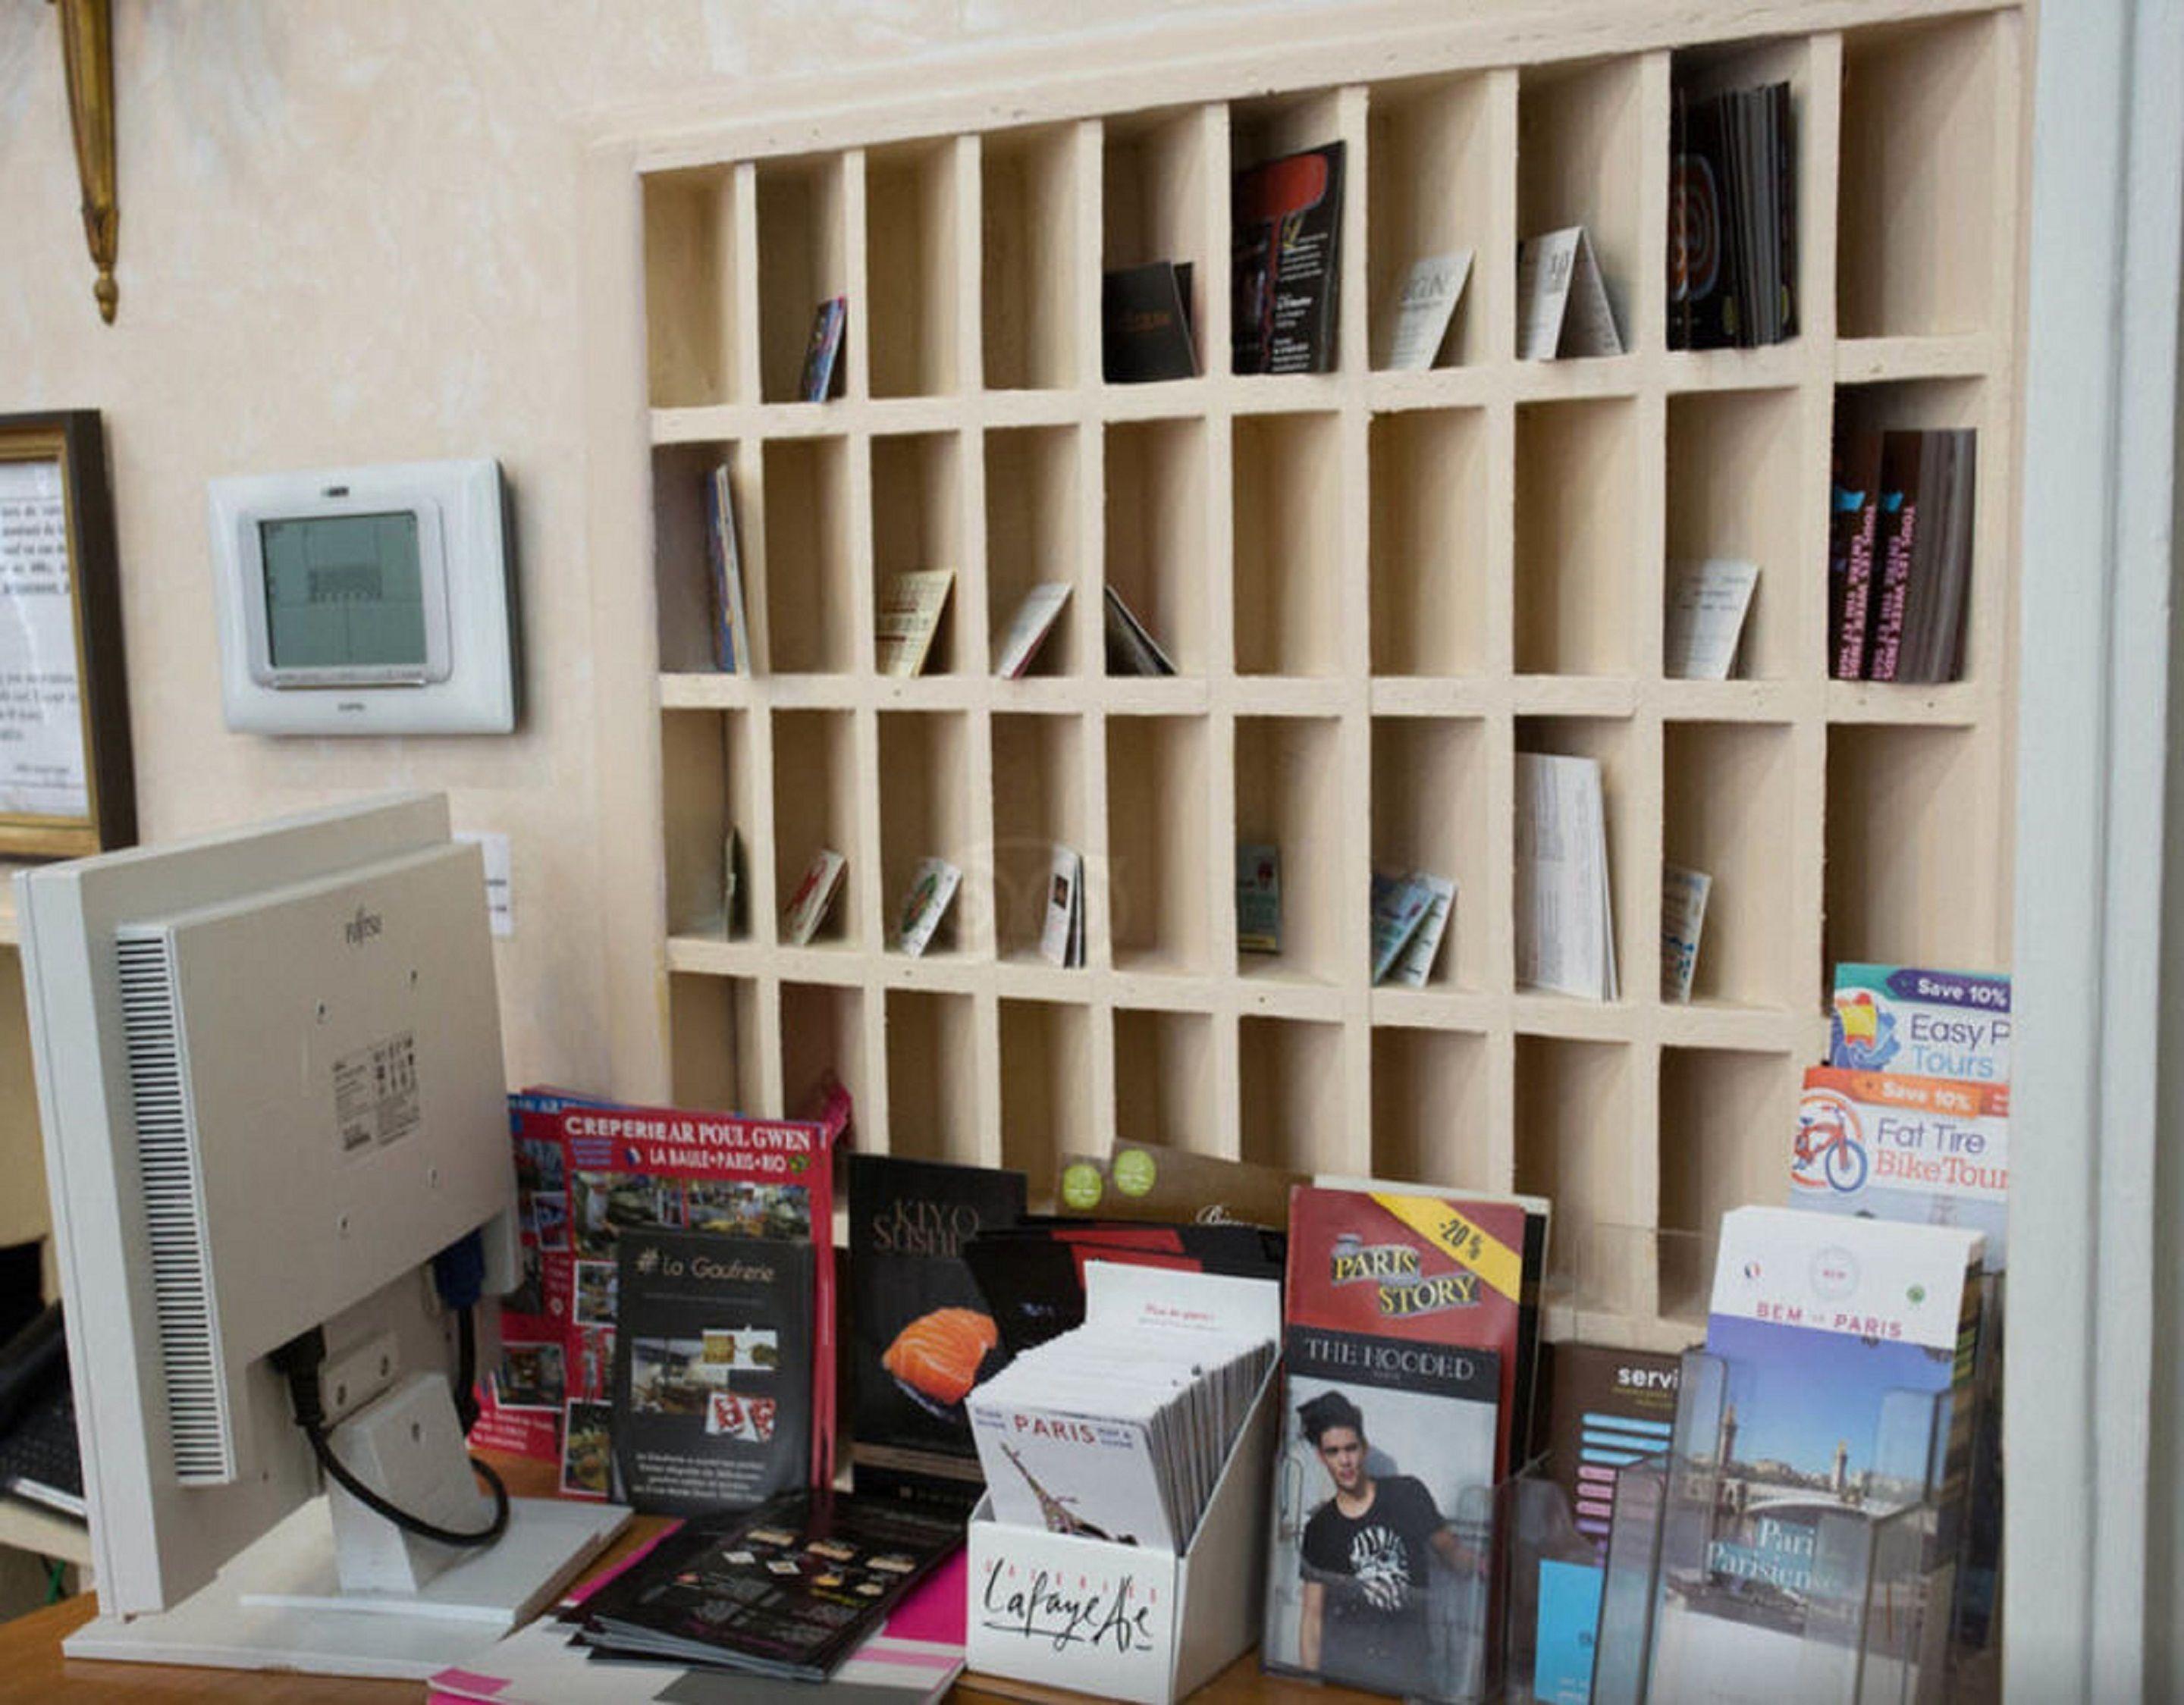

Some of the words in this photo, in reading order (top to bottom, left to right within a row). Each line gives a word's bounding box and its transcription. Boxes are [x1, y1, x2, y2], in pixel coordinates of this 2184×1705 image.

[1916, 977, 1964, 1000] Save
[1970, 983, 2008, 1007] 10%
[1910, 1013, 1985, 1051] Easy
[1991, 1020, 2010, 1045] P
[1911, 1046, 1994, 1079] Tours
[698, 1123, 750, 1148] POUL
[752, 1126, 811, 1152] GWEN
[1877, 1117, 1925, 1149] Fat
[1932, 1123, 1987, 1155] Tire
[1335, 1250, 1417, 1280] PARIS
[1379, 1274, 1476, 1314] STORY
[1756, 1301, 1803, 1321] BEM
[1834, 1313, 1903, 1340] PARIS
[1304, 1337, 1357, 1365] THE
[1363, 1344, 1476, 1381] HOODED
[1618, 1367, 1679, 1390] servi
[1014, 1413, 1097, 1443] PARIS
